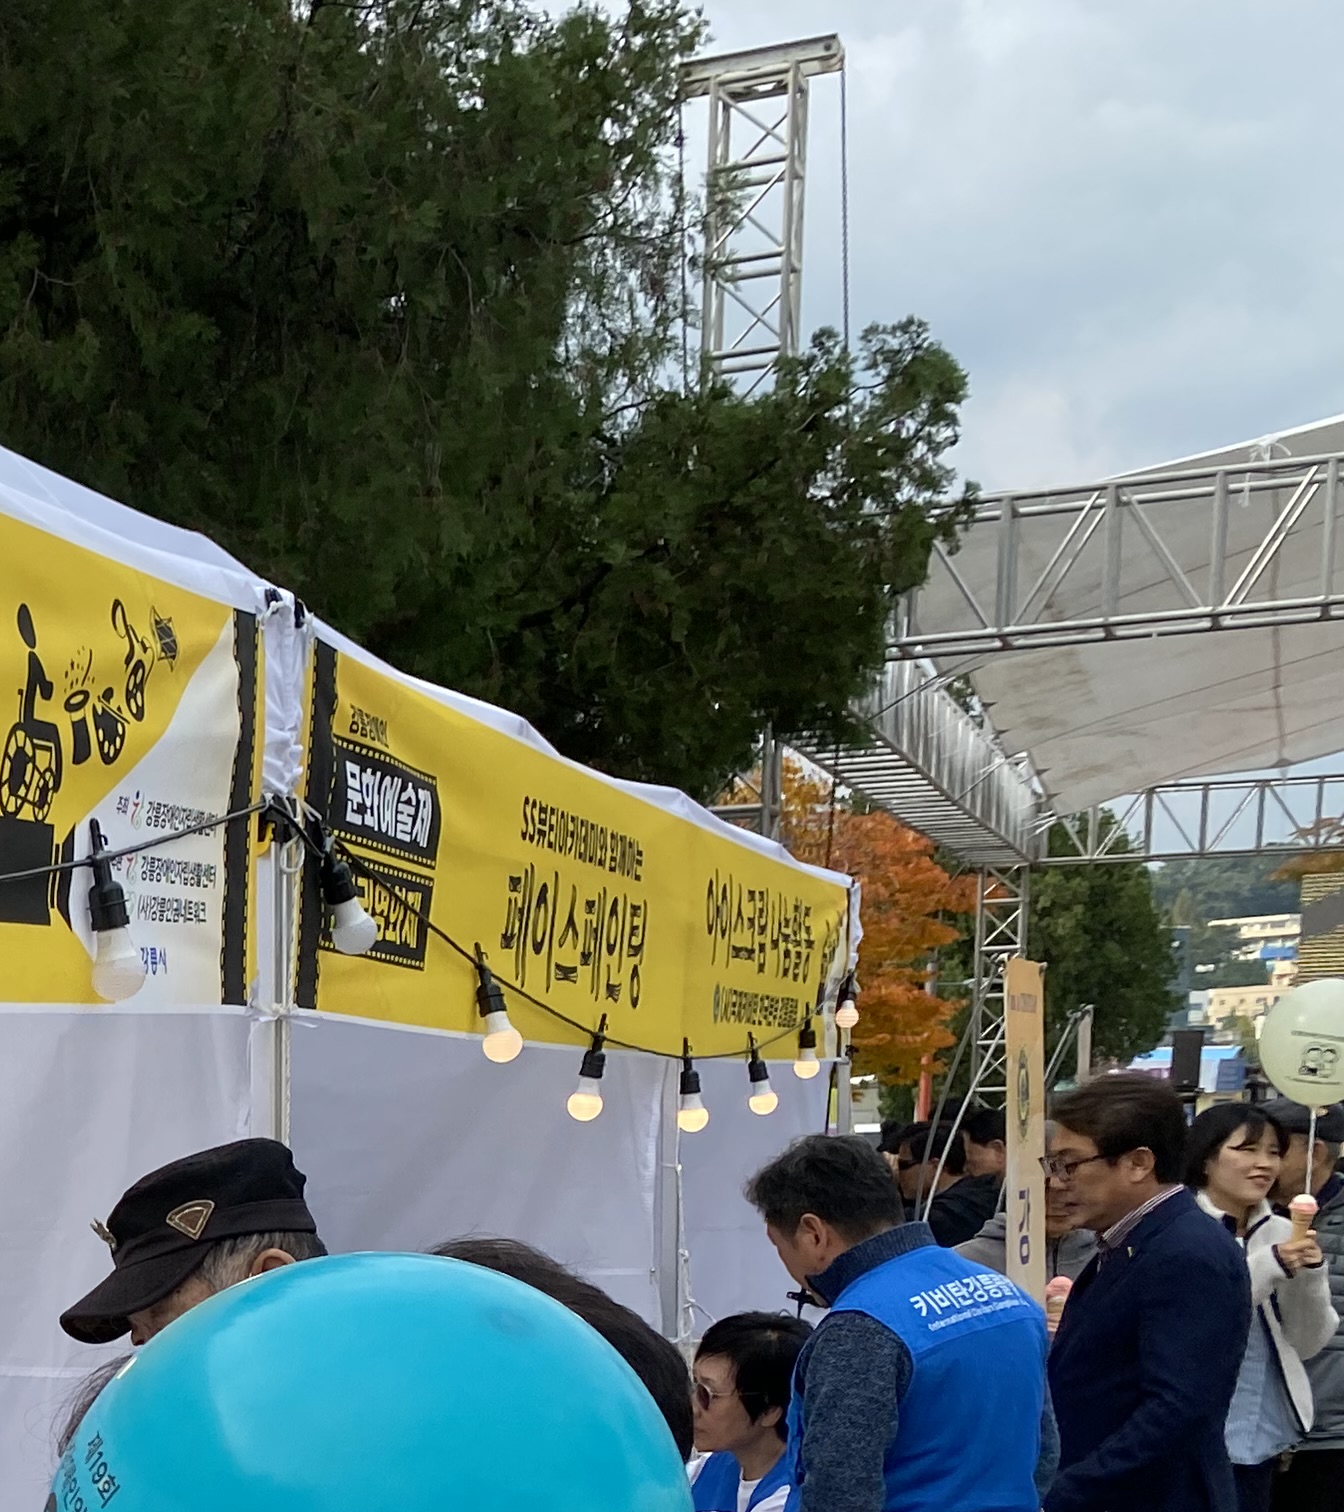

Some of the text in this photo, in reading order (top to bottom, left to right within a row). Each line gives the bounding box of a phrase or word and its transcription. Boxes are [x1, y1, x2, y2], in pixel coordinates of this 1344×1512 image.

[344, 759, 433, 849] 문화예술제
[500, 861, 648, 1010] 페이스페인팅
[707, 867, 770, 975] 아이스크림
[84, 1430, 121, 1510] 제19회
